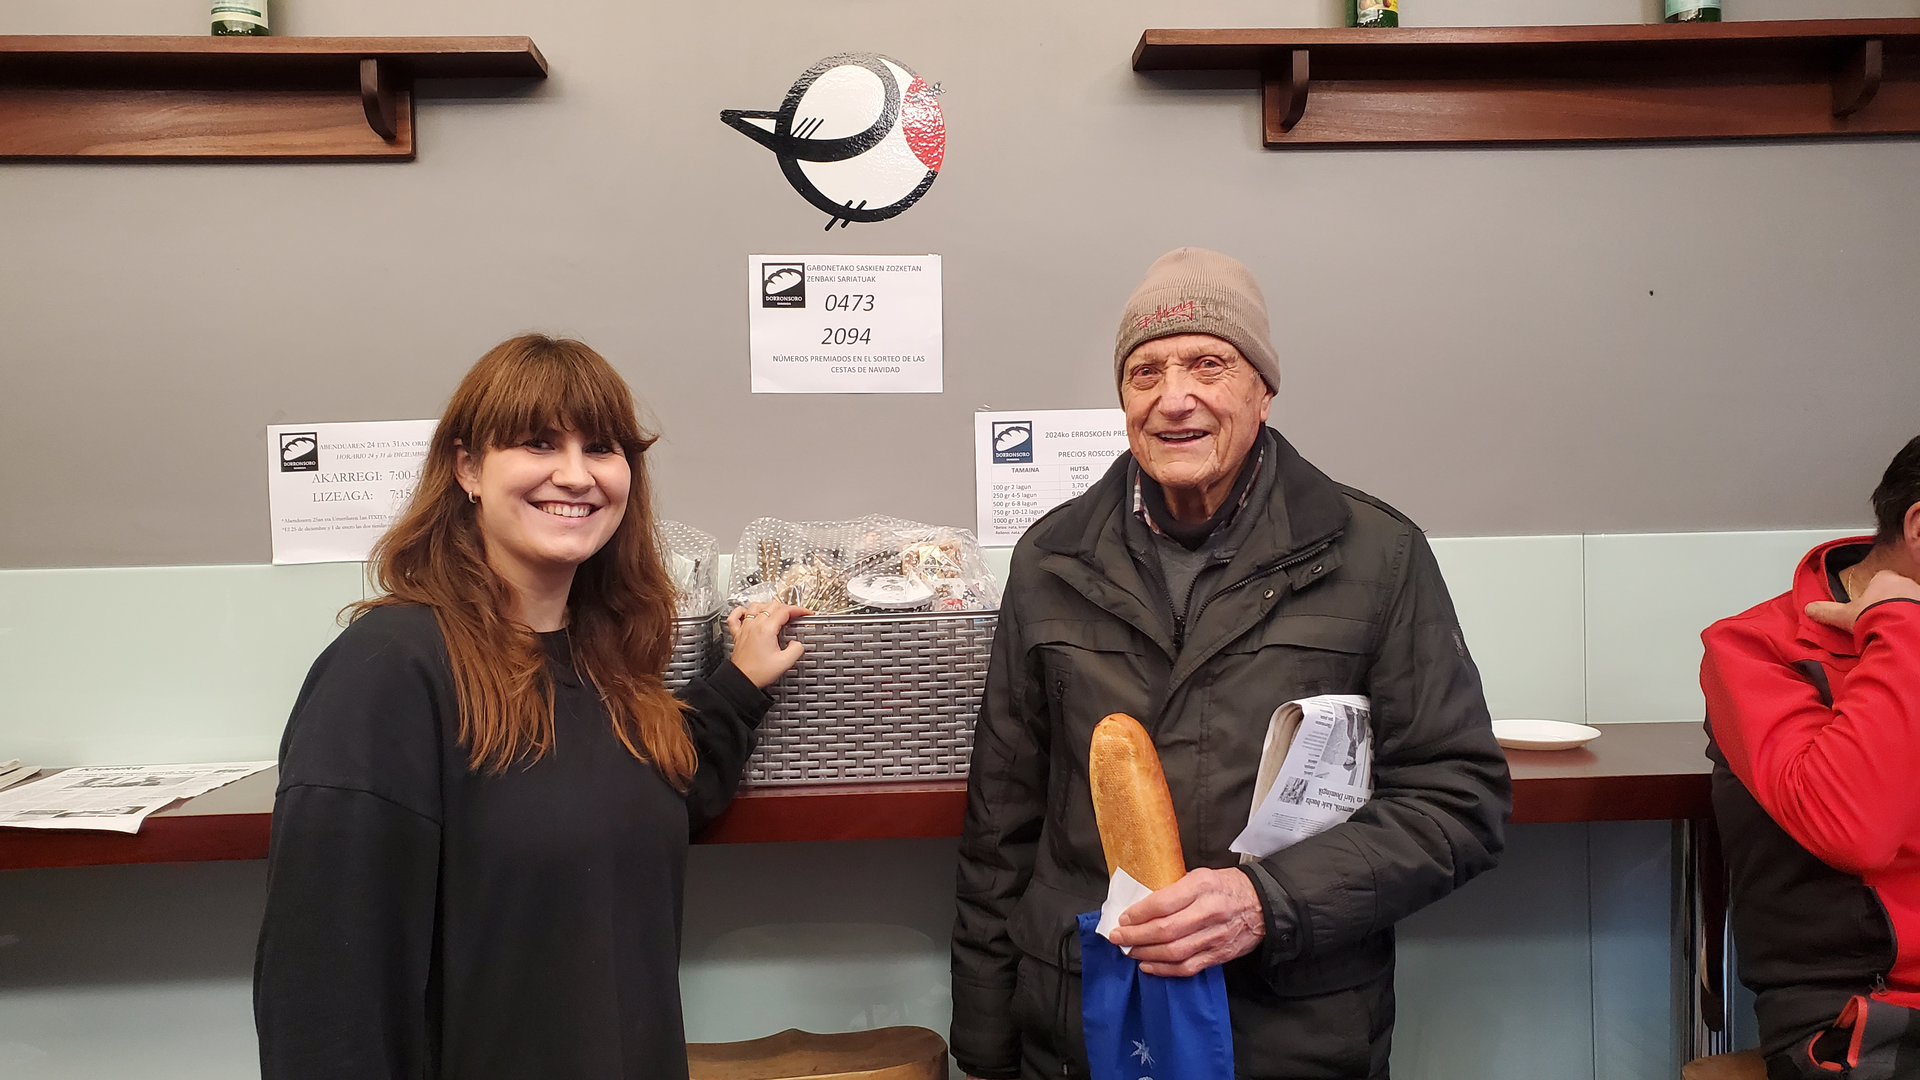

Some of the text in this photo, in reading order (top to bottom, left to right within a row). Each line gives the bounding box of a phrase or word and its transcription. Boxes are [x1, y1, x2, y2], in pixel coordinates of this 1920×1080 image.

[825, 294, 875, 312] 0473
[821, 328, 871, 345] 2094
[773, 354, 808, 362] NÚMEROS
[312, 472, 383, 484] AKARREGI:
[312, 490, 373, 502] LIZEAGA:
